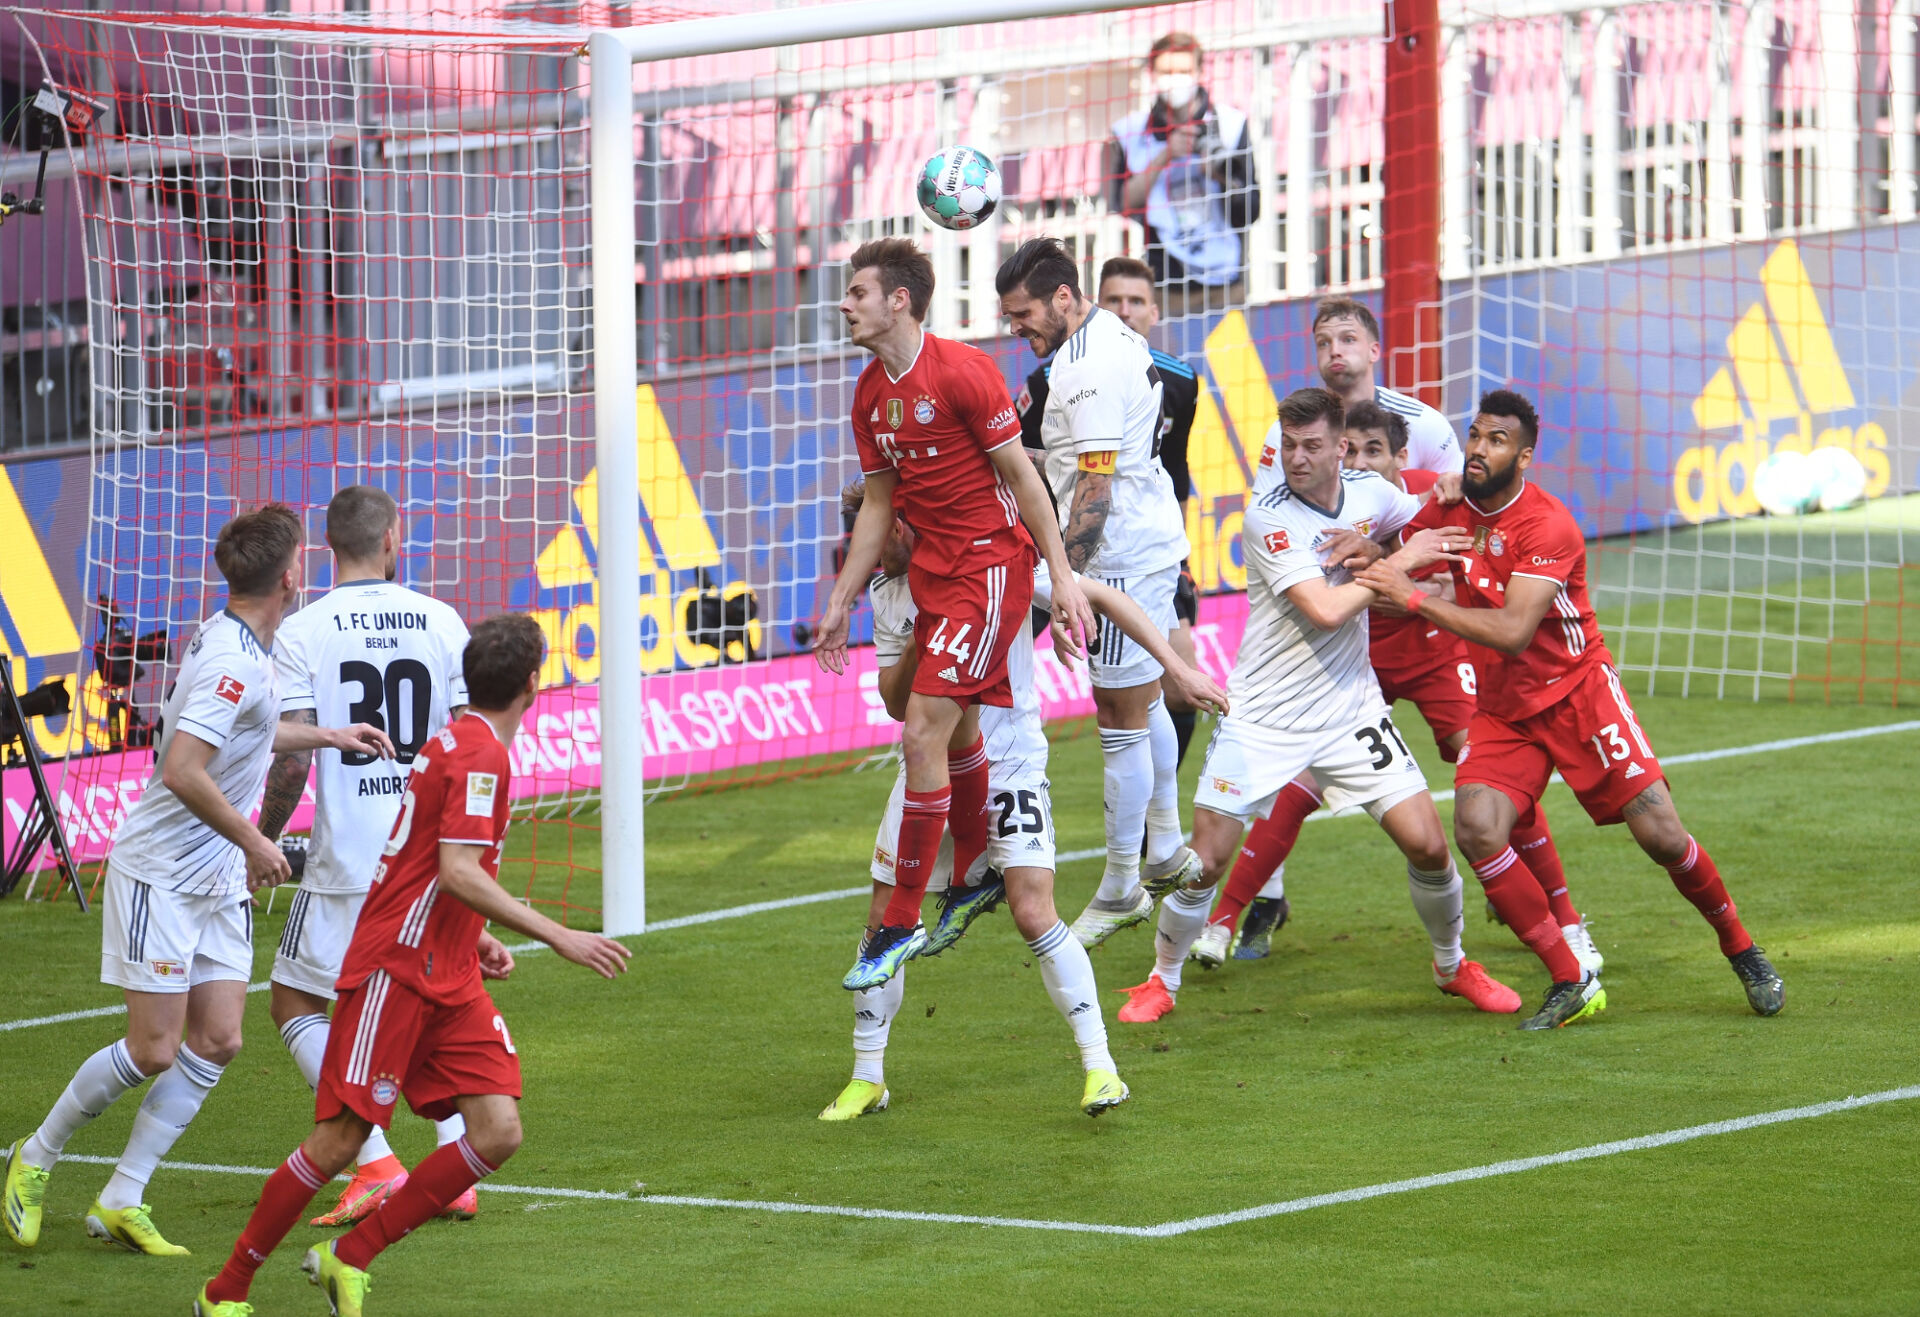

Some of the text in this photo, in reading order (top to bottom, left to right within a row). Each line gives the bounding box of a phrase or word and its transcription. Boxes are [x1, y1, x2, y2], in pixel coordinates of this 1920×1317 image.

[1066, 387, 1098, 407] wefox
[986, 406, 1015, 429] QATAR
[333, 611, 427, 632] 1. FC UNION
[926, 617, 972, 665] 44
[365, 636, 398, 649] BERLIN
[1456, 662, 1477, 695] 8
[339, 658, 432, 767] 30
[680, 678, 824, 751] SPORT
[1354, 717, 1409, 771] 31
[1591, 722, 1631, 769] 13
[992, 789, 1044, 839] 25
[898, 857, 921, 868] FCB
